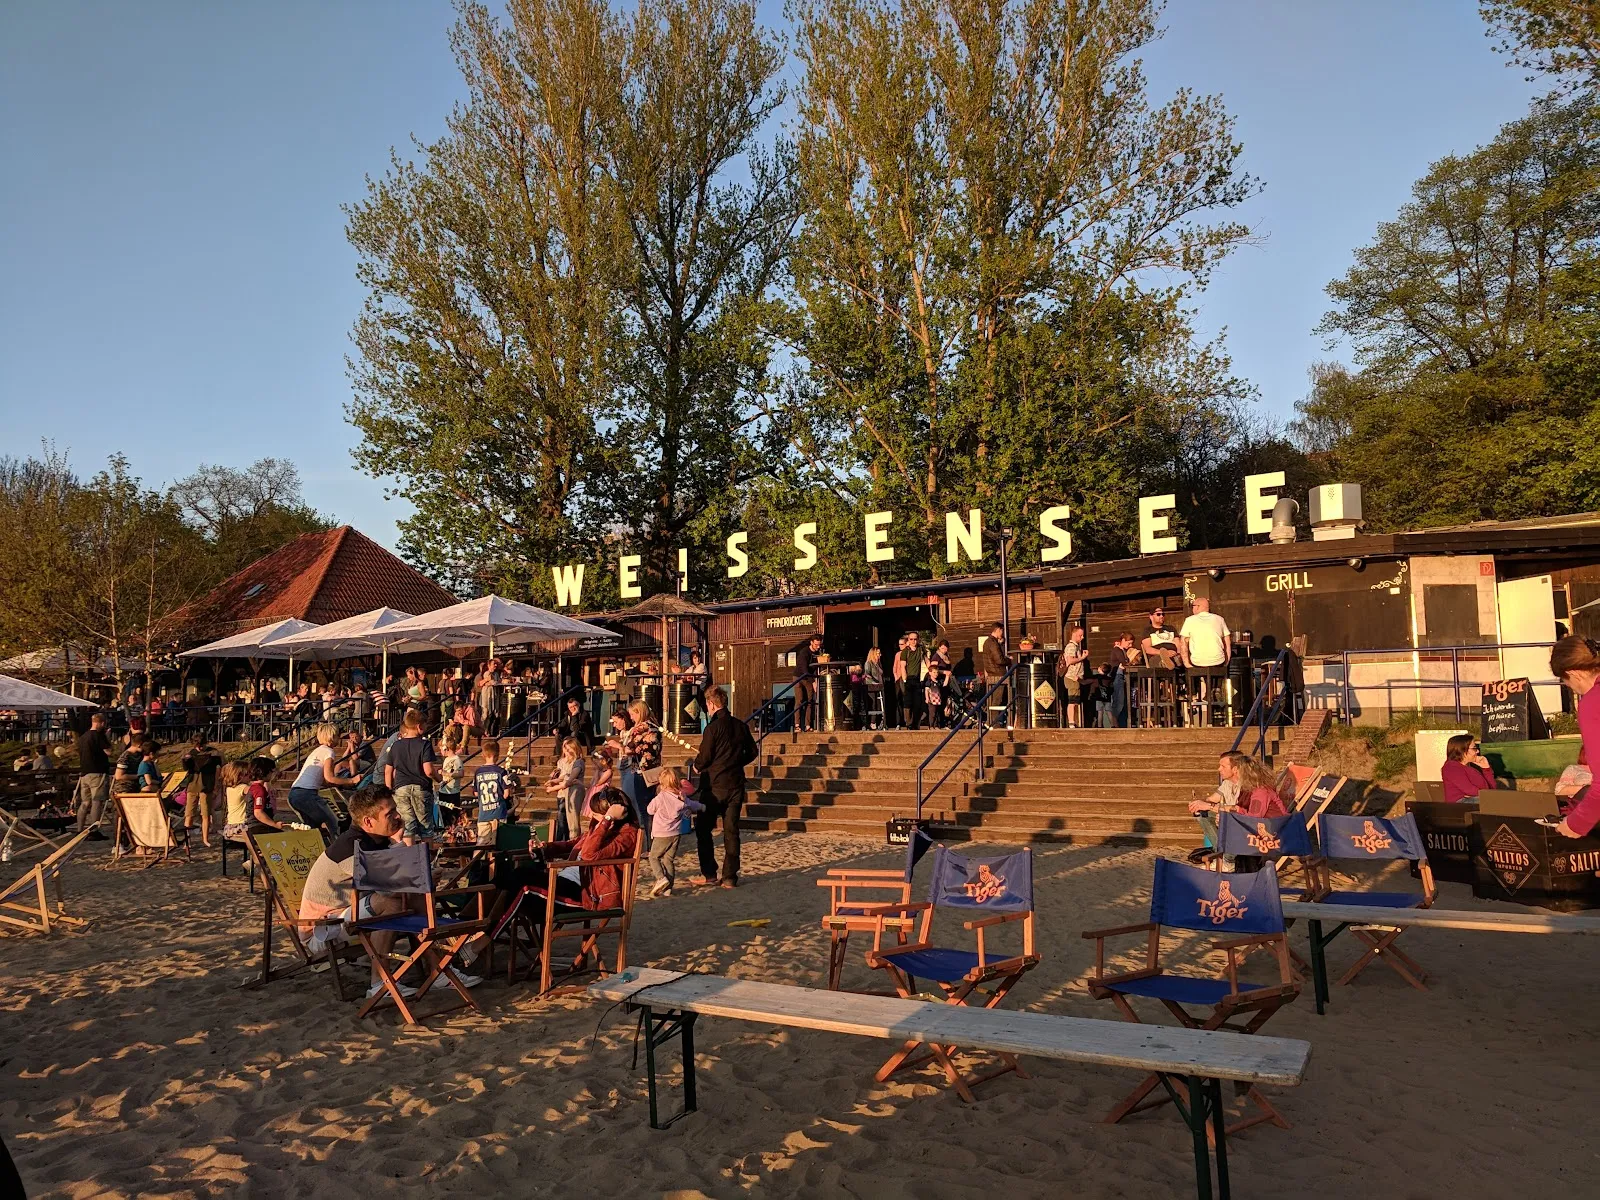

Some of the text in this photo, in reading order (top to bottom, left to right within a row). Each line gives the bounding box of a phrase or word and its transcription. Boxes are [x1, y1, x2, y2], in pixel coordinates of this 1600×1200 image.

[552, 471, 1286, 607] WEISSENSEE
[1266, 571, 1313, 591] GRILL
[1482, 680, 1527, 701] Tiger
[1494, 703, 1515, 711] werde
[1488, 723, 1519, 733] bepflanzt
[480, 781, 498, 804] 33
[1247, 834, 1281, 853] Tiger
[1351, 834, 1392, 854] Tiger
[1487, 850, 1529, 866] SALITOS
[1495, 863, 1523, 871] IMPORTED
[963, 881, 1006, 904] Tiger
[1196, 898, 1248, 925] Tiger
